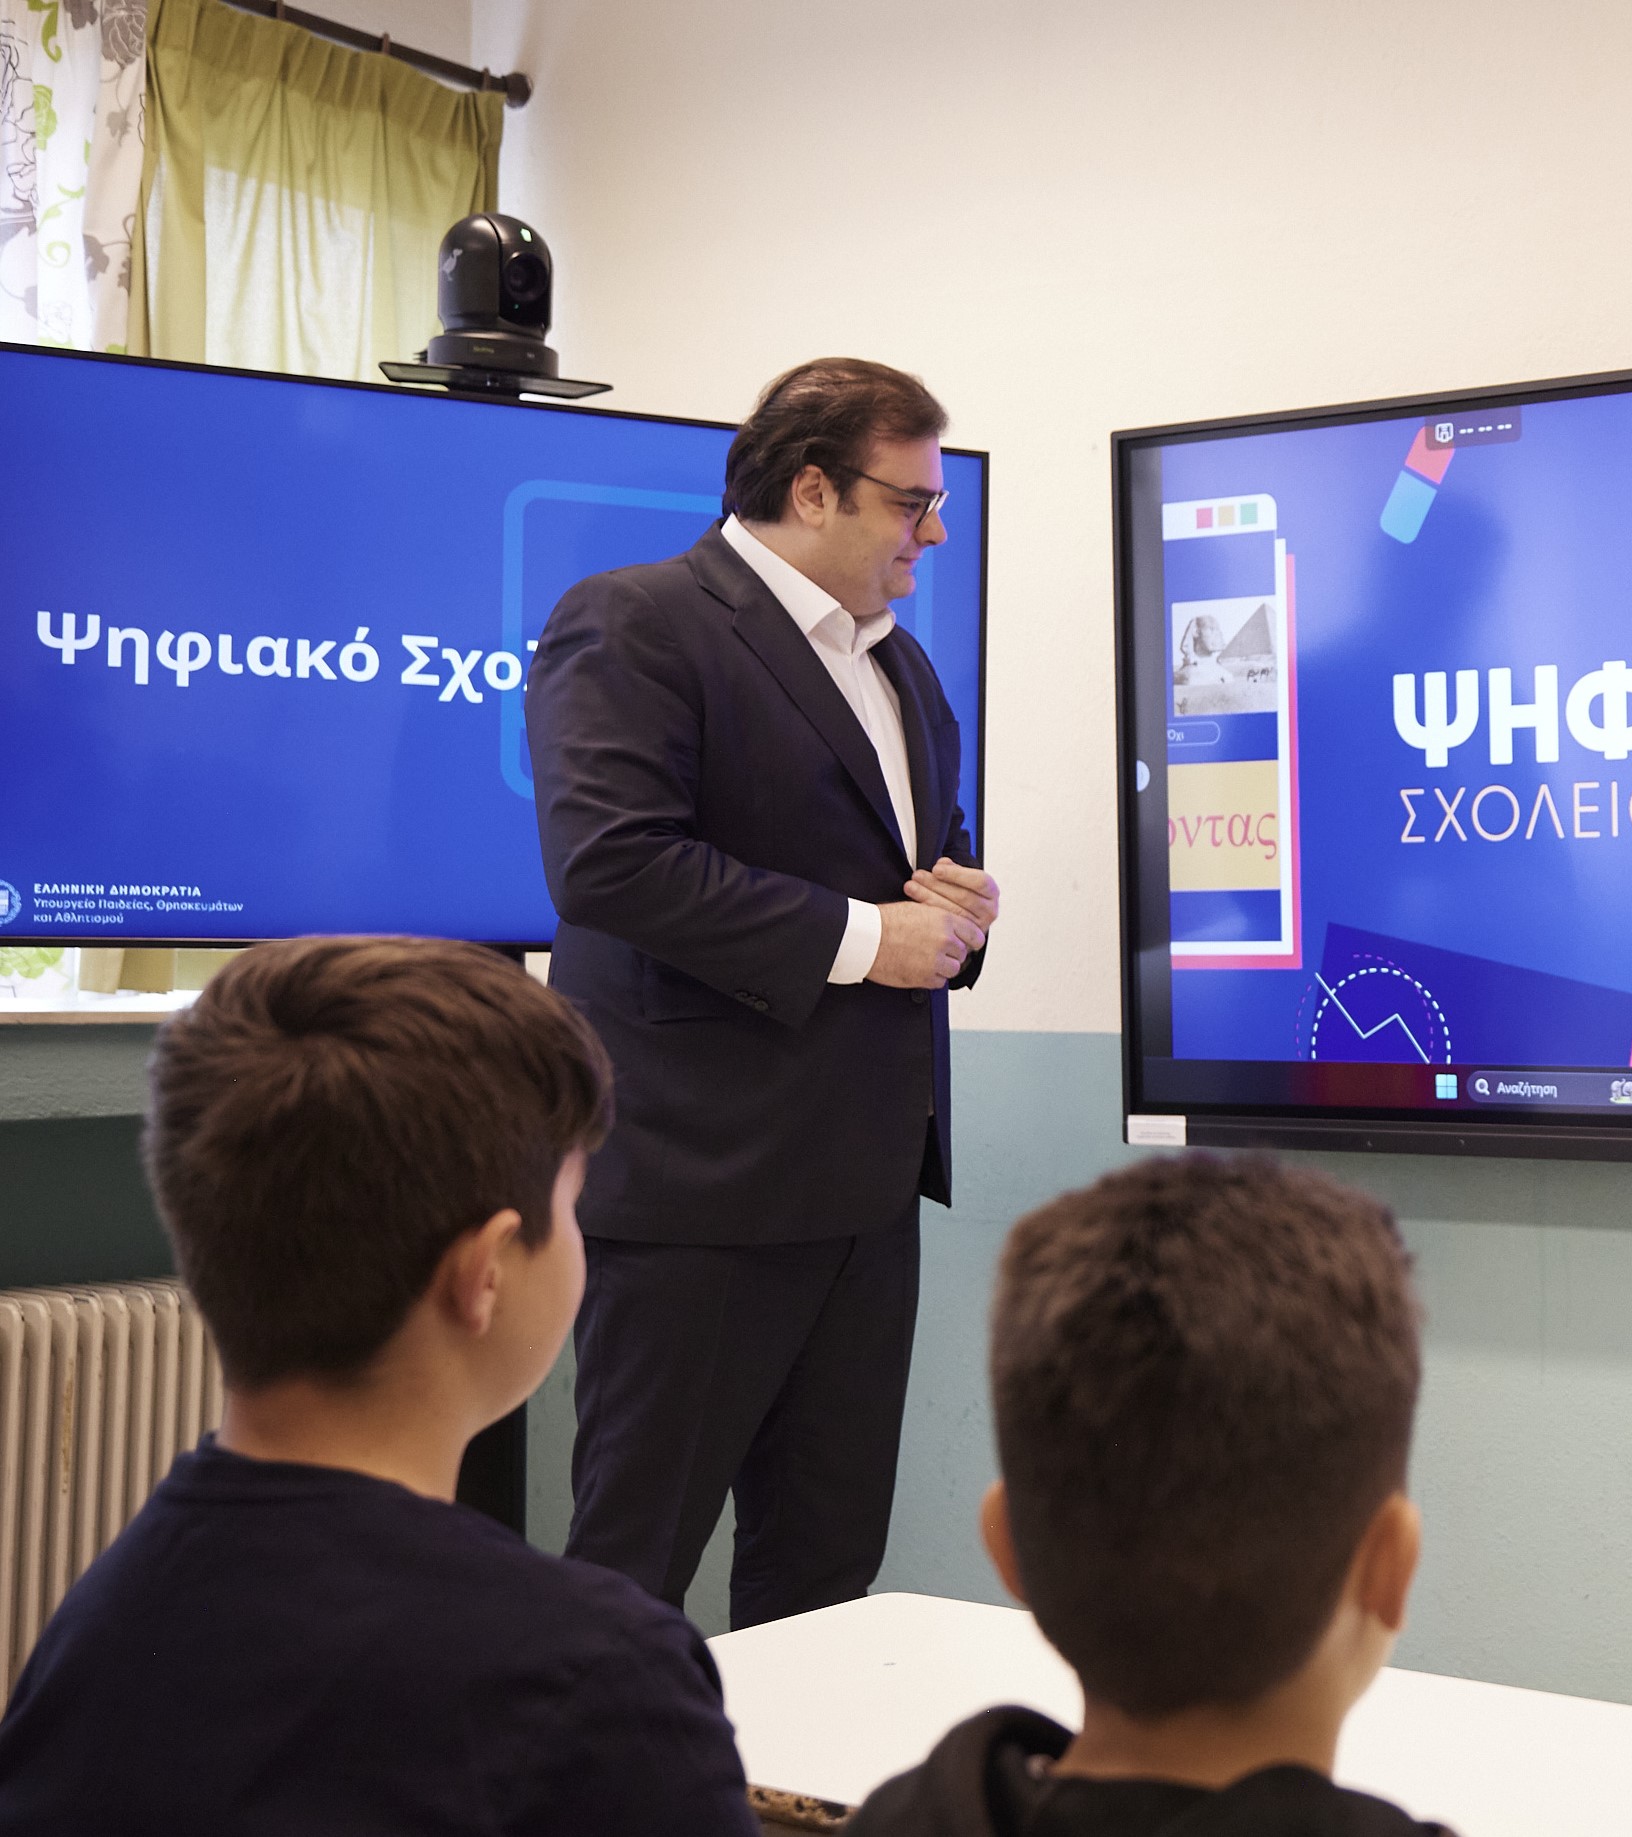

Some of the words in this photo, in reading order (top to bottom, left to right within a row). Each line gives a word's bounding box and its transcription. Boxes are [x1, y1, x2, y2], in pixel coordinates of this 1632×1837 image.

[37, 610, 381, 688] Ψηφιακό
[33, 883, 105, 896] ΕΛΛΗΝΙΚΗ
[109, 884, 202, 897] ΔΗΜΟΚΡΑΤΙΑ
[33, 898, 96, 911] Υπουργείο
[33, 913, 52, 923] και
[1496, 1080, 1558, 1099] Αναζήτηση
